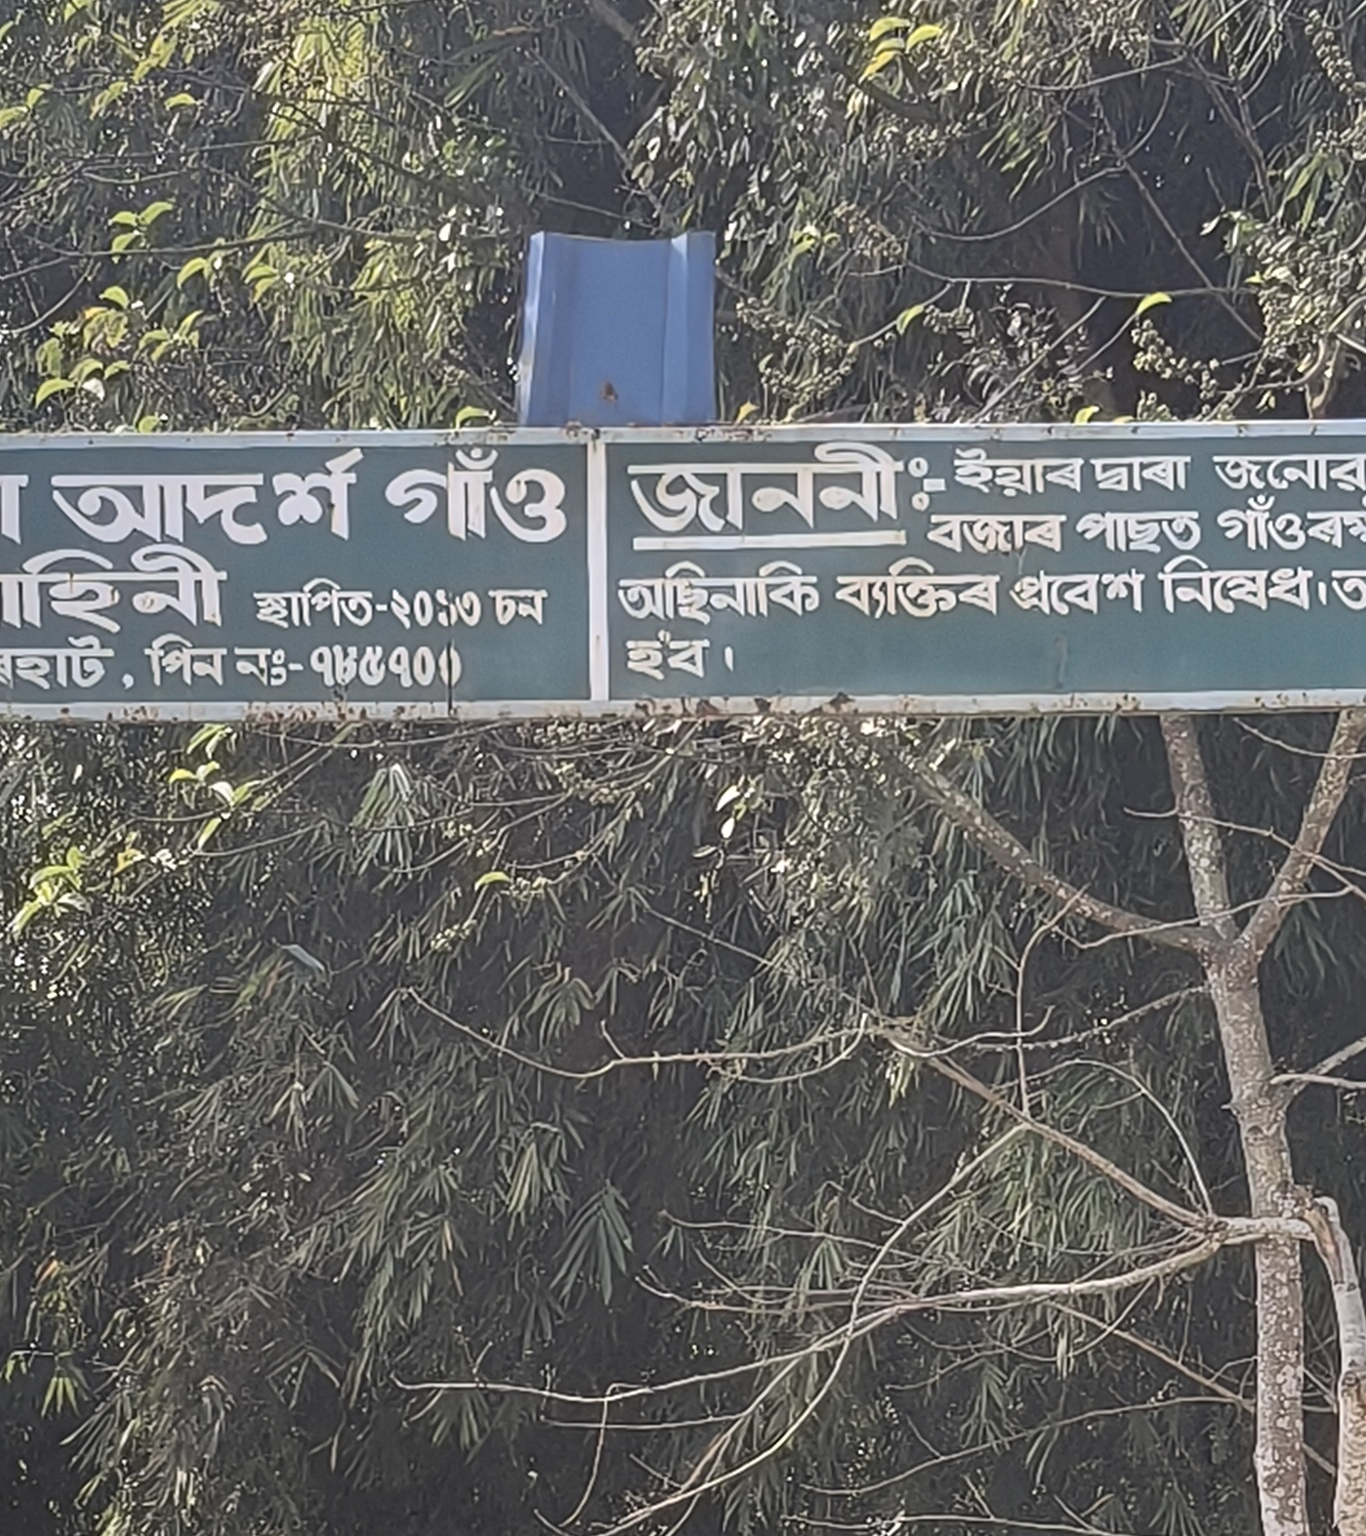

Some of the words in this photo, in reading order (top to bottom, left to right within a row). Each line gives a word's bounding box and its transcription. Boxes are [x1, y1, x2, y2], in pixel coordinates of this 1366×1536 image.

[385, 447, 567, 543] গাঁও
[954, 447, 1084, 497] ইয়াৰ
[1090, 455, 1191, 491] দ্বাৰা
[927, 514, 1067, 554] বজাৰ
[1076, 511, 1201, 553] পাছত
[489, 589, 548, 625] চন
[617, 560, 820, 624] অছিনাকি
[836, 556, 1000, 618] ব্যক্তিৰ
[1010, 569, 1144, 615] প্ৰবেশ
[145, 634, 227, 686] পিন
